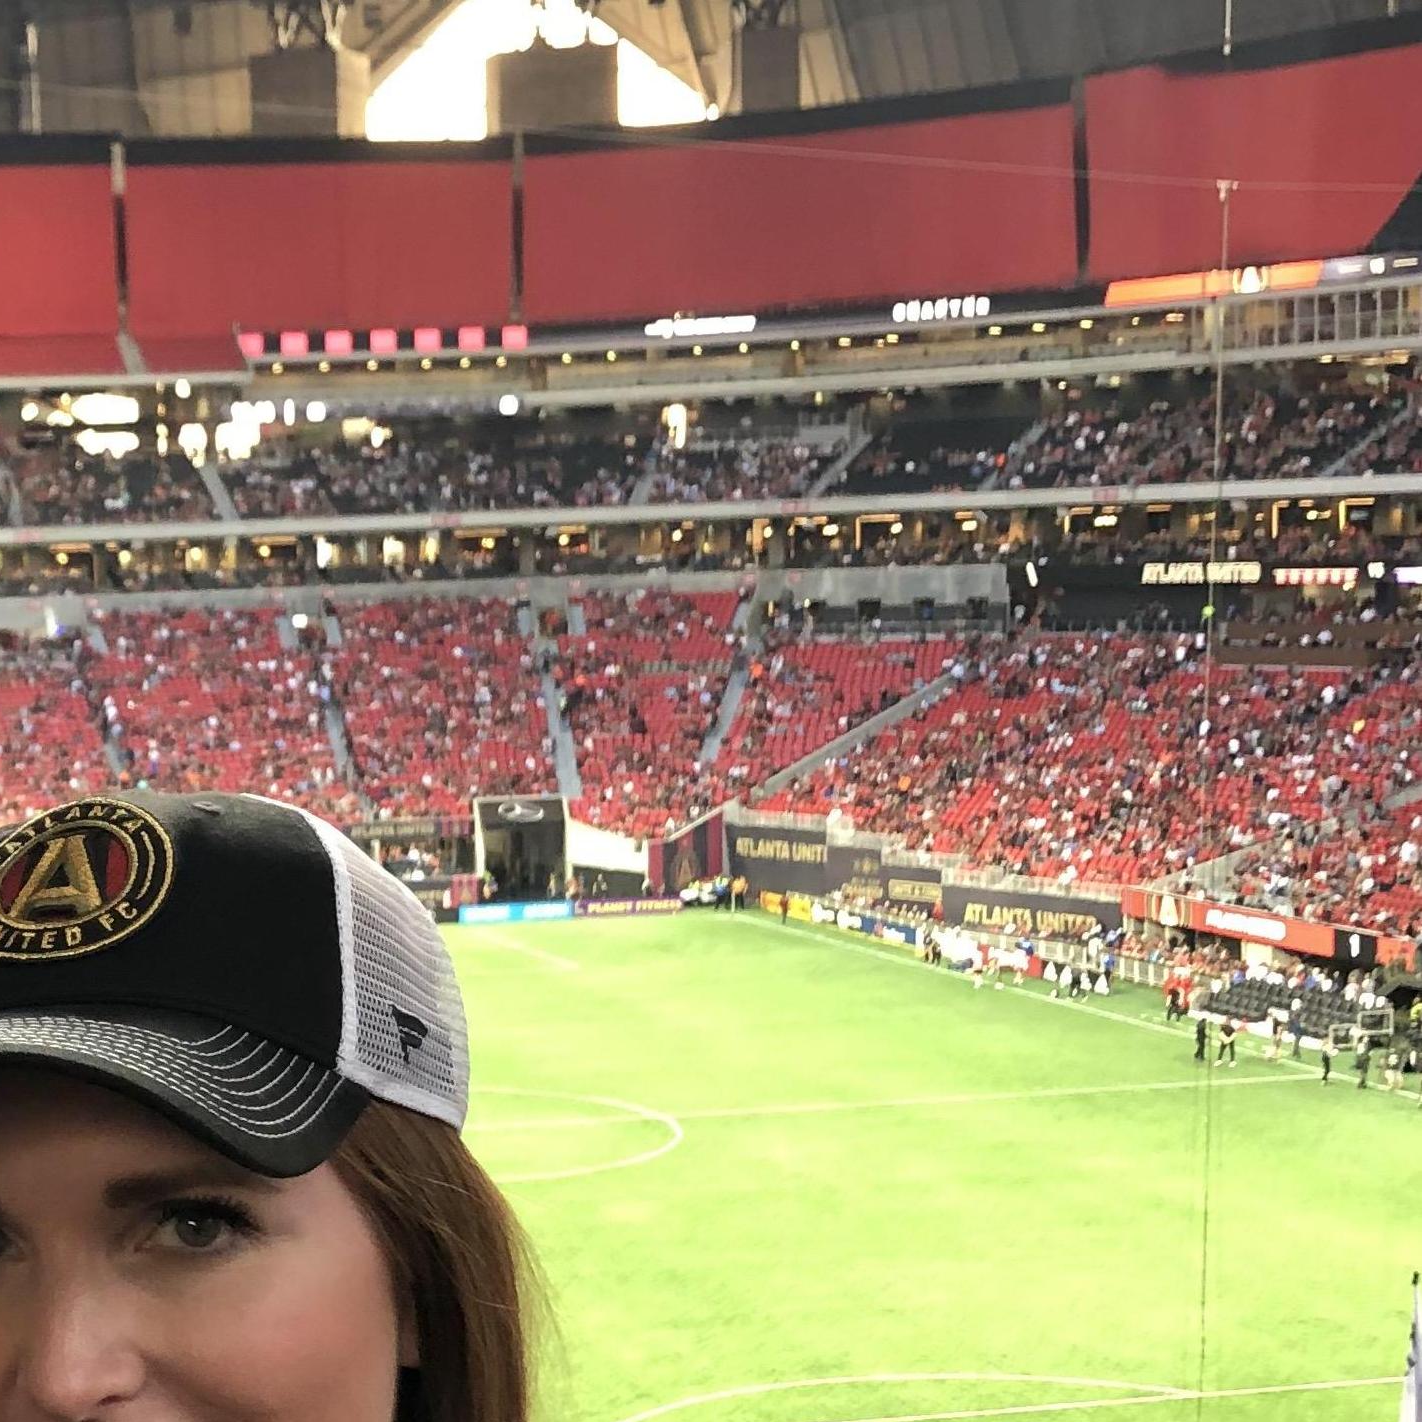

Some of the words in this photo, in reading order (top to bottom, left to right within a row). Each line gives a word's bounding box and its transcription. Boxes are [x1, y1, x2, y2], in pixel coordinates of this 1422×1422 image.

[4, 805, 145, 854] ATLANTA
[735, 836, 790, 862] ATLANTA
[792, 842, 826, 864] UNIT
[8, 833, 103, 917] A
[98, 902, 137, 931] FC
[964, 902, 1033, 932] ATLANTA
